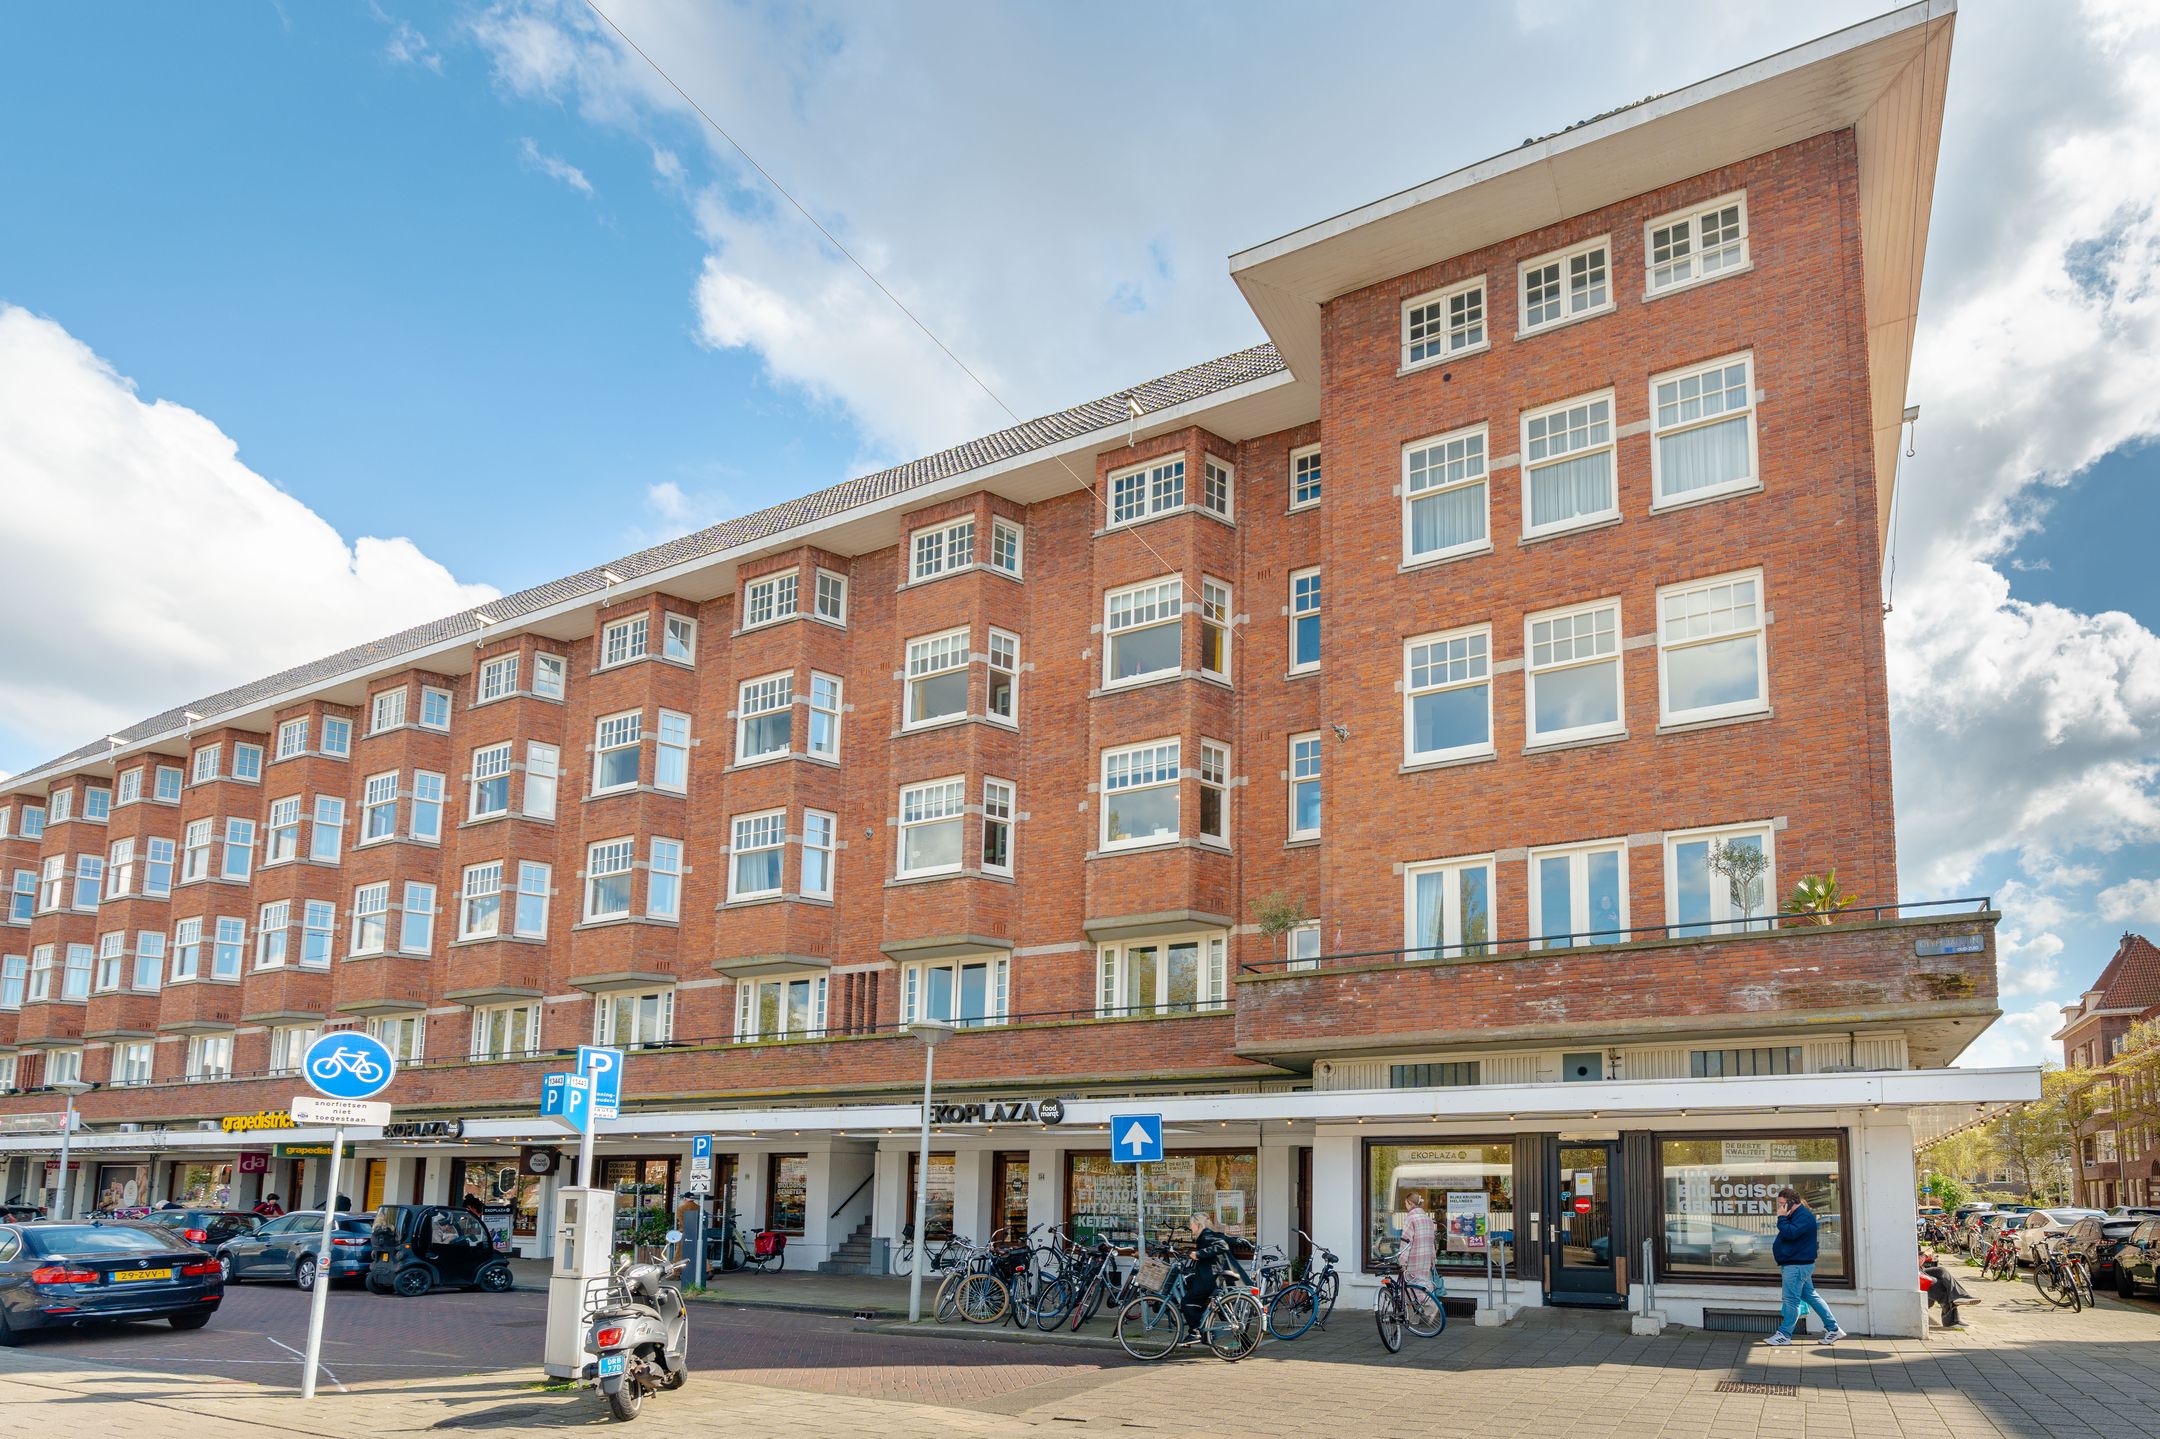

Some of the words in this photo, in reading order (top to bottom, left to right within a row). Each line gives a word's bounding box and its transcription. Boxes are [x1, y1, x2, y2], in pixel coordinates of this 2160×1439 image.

[590, 1053, 612, 1073] P
[315, 1101, 367, 1109] snorfietsen
[547, 1090, 558, 1112] P
[570, 1090, 581, 1112] P
[697, 1138, 707, 1155] P
[1725, 1148, 1767, 1156] KWALITEIT
[1411, 1151, 1456, 1159] EKOPLAZA
[242, 1156, 264, 1170] da
[1078, 1203, 1097, 1214] UIT
[1100, 1203, 1116, 1214] DE
[1680, 1200, 1772, 1214] GENIETEN
[1077, 1215, 1118, 1227] KETEN
[121, 1271, 165, 1279] 29-ZVV-1
